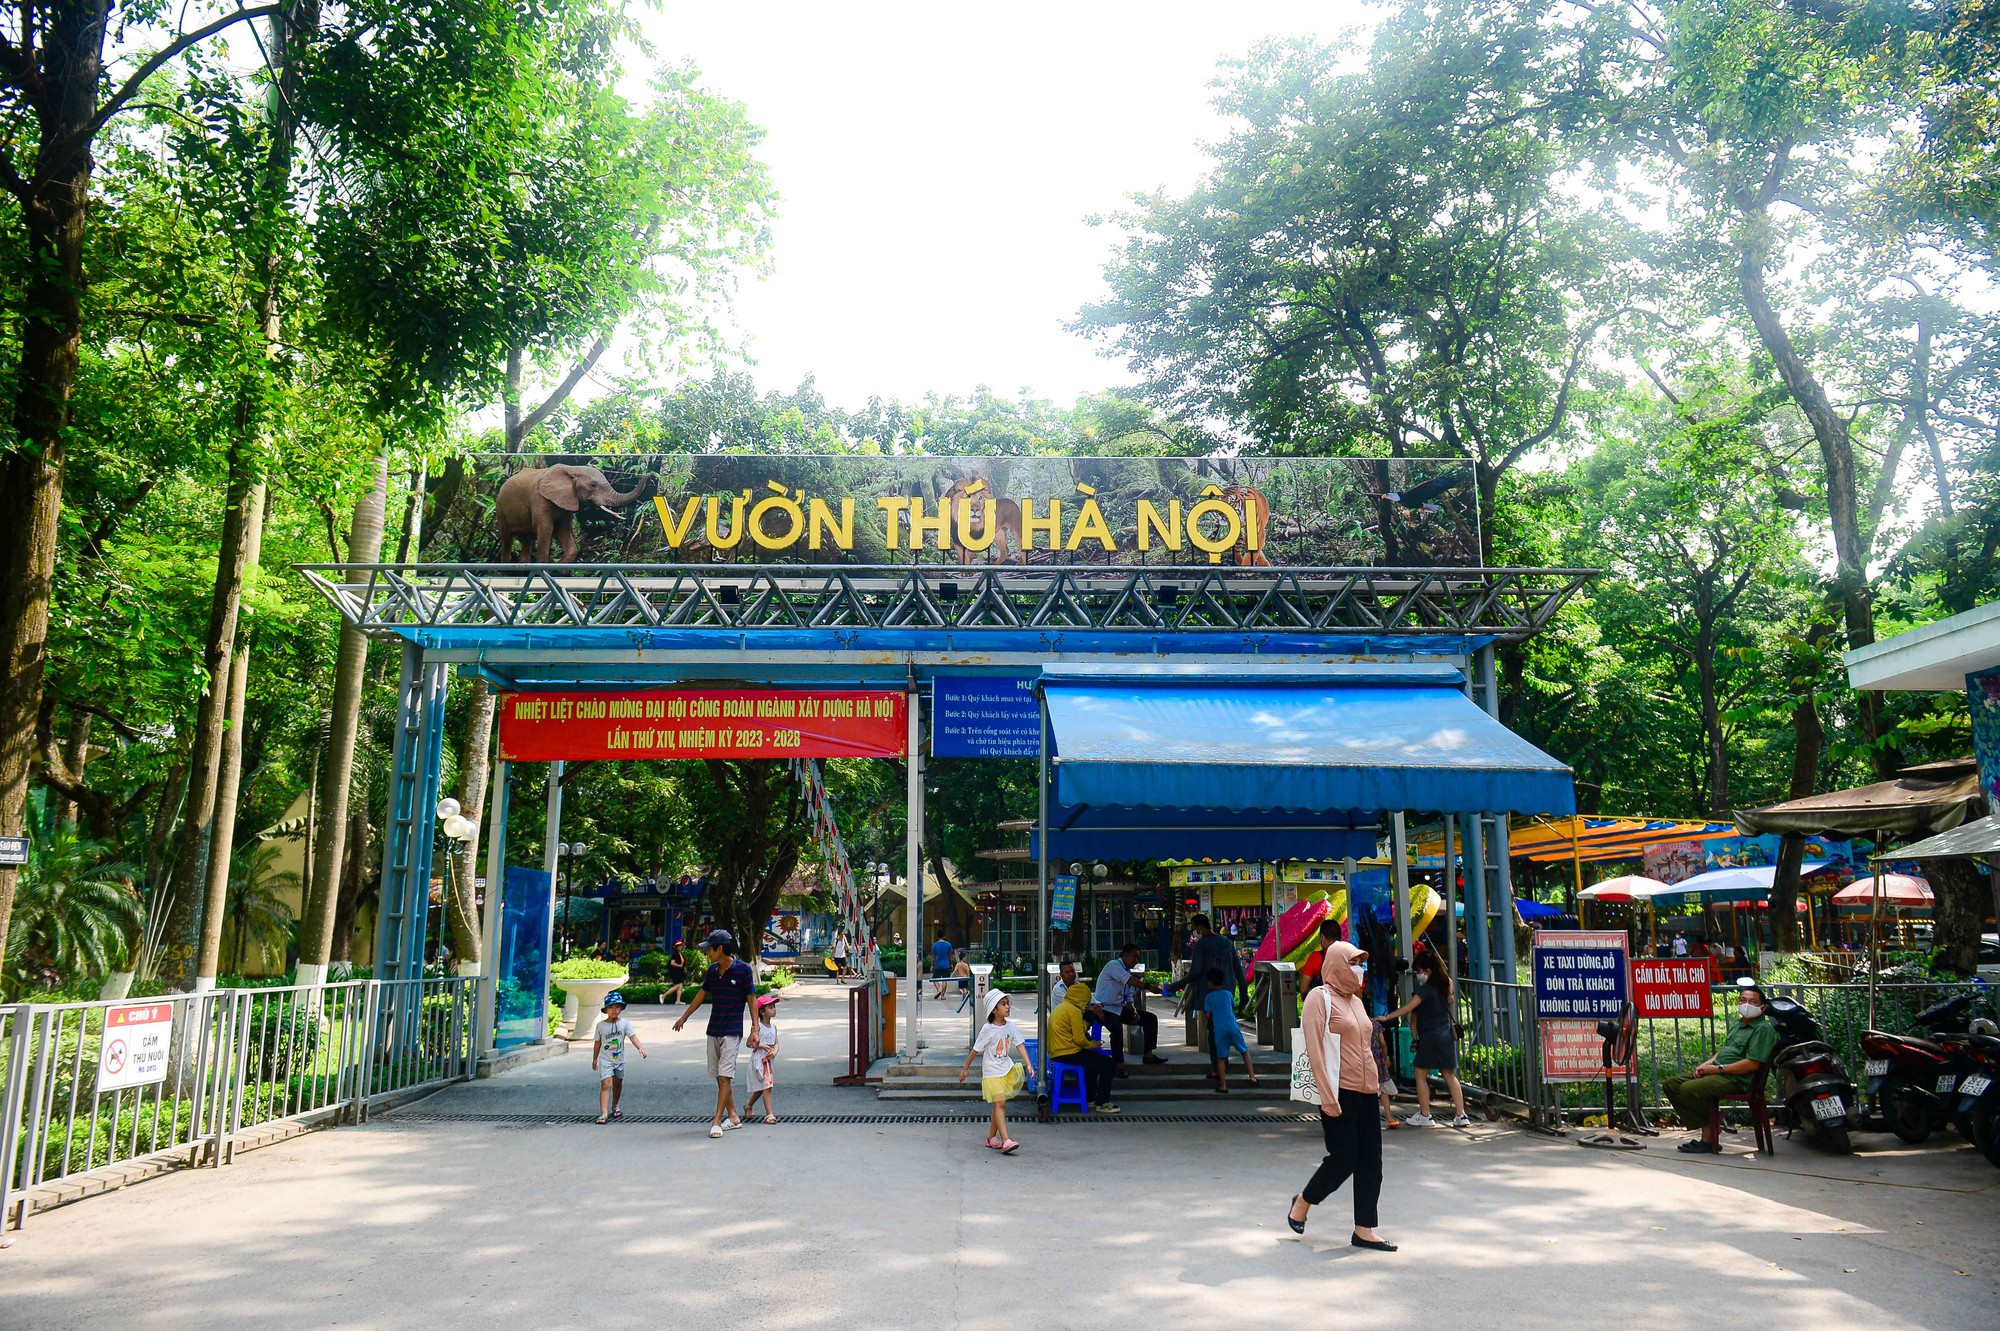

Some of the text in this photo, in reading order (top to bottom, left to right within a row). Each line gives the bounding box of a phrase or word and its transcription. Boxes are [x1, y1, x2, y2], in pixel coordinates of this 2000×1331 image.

[653, 479, 1259, 563] VƯỜN THÚ HÀ NỘI
[981, 694, 1000, 702] khách
[515, 696, 894, 723] NHIỆT LIỆT CHÀO MỪNG ĐẠI HỘI CÔNG ĐOÀN NGÀNH XÂY DỰNG HÀ NỘI
[945, 710, 960, 718] Bước
[944, 726, 960, 734] Bước
[632, 727, 654, 748] THỨ
[656, 729, 675, 750] XIV,
[679, 726, 715, 751] NHIỆM
[718, 726, 733, 748] KỲ
[736, 730, 763, 747] 2023
[773, 730, 800, 747] 2028
[1543, 956, 1555, 969] XE
[1557, 956, 1575, 969] TAXI
[1635, 962, 1706, 985] CẤM DẮT, THẢ CHÓ
[1546, 974, 1615, 990] ĐÓN TRẢ KHÁCH
[1540, 997, 1622, 1012] KHÔNG QUÁ 5 PHÚT
[1645, 991, 1700, 1010] VÀO VƯỜN THÚ
[128, 1007, 159, 1022] CHÚ Ý
[142, 1033, 158, 1048] CẤM
[133, 1049, 164, 1064] THÚ NUÔI
